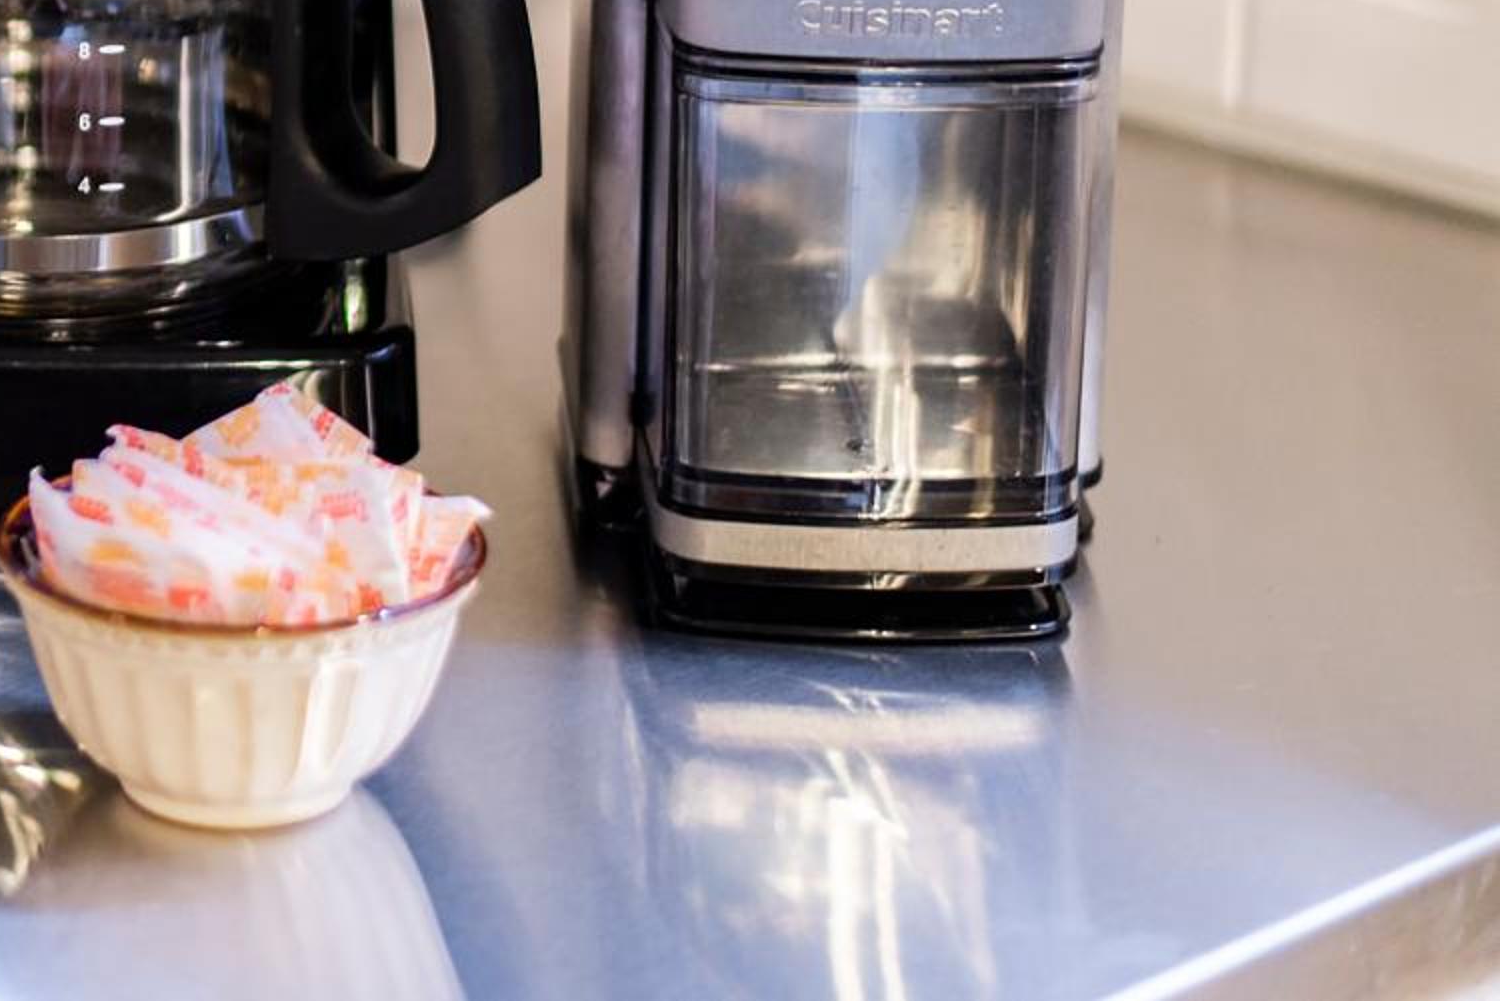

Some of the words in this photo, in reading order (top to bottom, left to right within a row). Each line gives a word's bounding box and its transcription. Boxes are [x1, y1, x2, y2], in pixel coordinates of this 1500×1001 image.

[78, 41, 91, 60] 8
[78, 113, 91, 131] 6
[77, 176, 91, 194] 4
